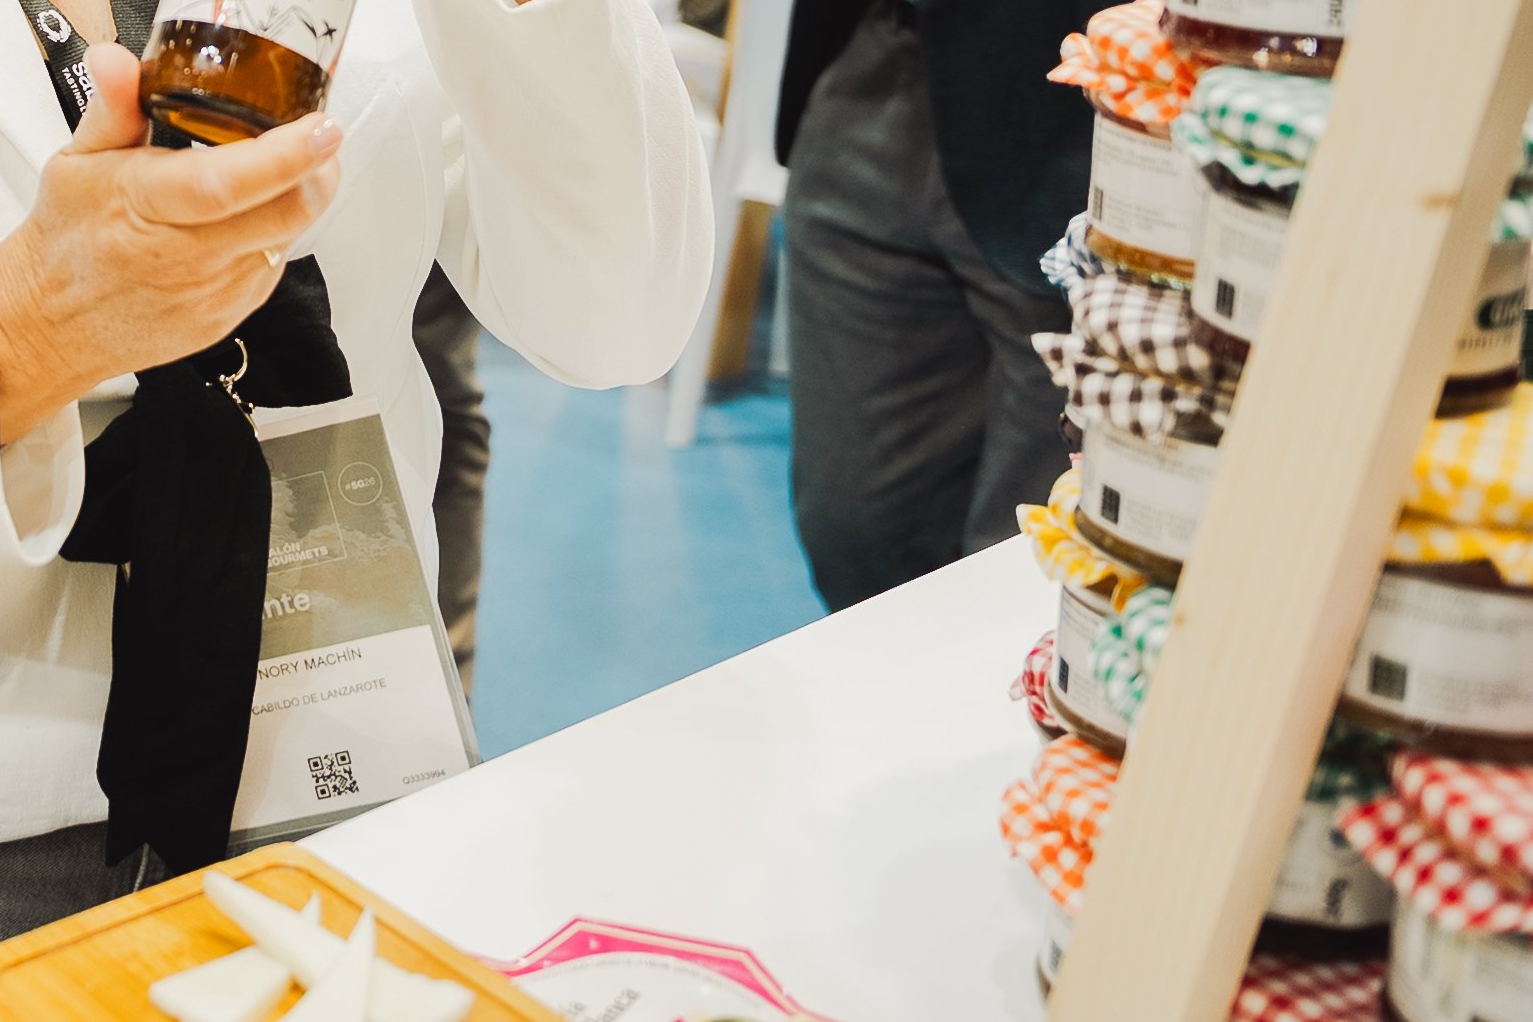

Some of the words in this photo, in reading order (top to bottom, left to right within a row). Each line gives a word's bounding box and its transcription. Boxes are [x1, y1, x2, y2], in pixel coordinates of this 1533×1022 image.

[269, 542, 300, 557] ALÓN
[264, 593, 311, 619] nte
[258, 661, 299, 679] NORY
[304, 647, 362, 670] MACHÍN
[251, 698, 300, 716] CABILDO
[302, 692, 318, 704] DE
[321, 678, 387, 701] LANZAROTE
